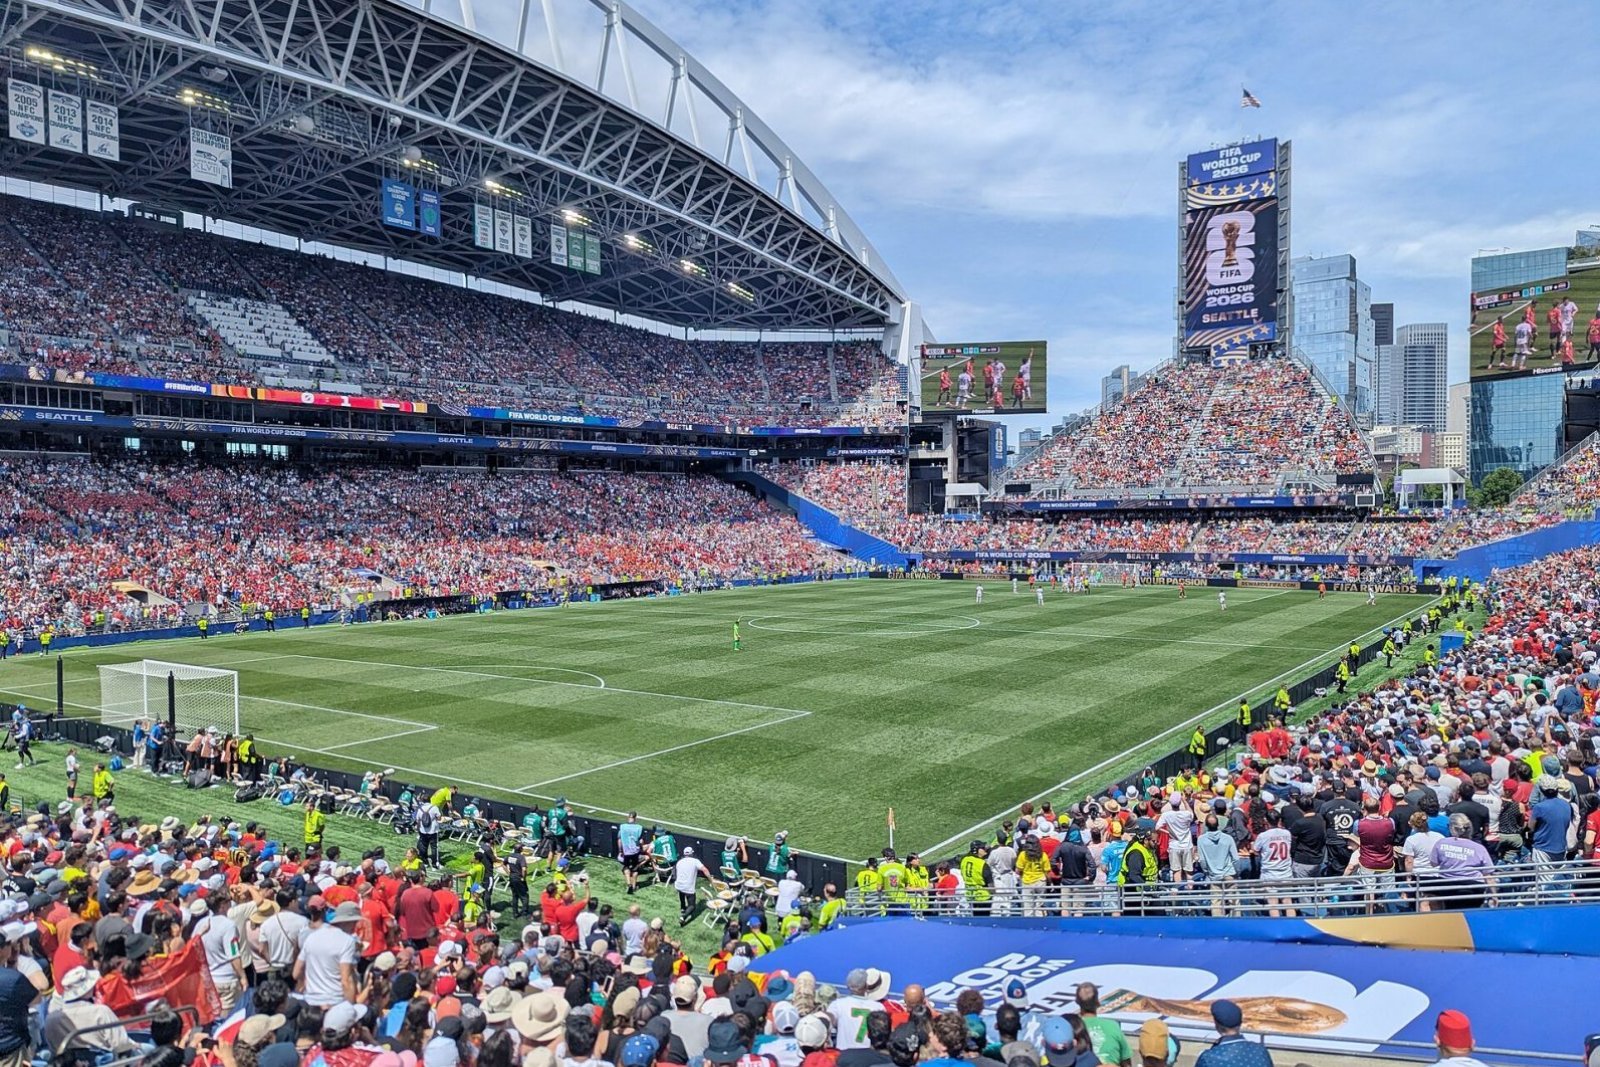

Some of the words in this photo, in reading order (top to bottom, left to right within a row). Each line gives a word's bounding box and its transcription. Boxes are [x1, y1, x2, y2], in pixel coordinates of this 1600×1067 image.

[14, 94, 38, 107] 2005
[18, 104, 35, 114] NFC
[53, 105, 77, 118] 2013
[9, 110, 44, 123] CHAMPIONS
[57, 115, 74, 125] NFC
[91, 114, 114, 127] 2014
[95, 124, 111, 134] NFC
[192, 129, 208, 139] 2013
[192, 136, 230, 150] CHAMPIONS
[1219, 146, 1242, 159] FIFA
[1201, 157, 1239, 172] WORLD
[1240, 152, 1262, 164] CUP
[1212, 164, 1249, 179] 2026
[1220, 269, 1242, 279] FIFA
[1206, 285, 1237, 296] WORLD
[1237, 284, 1255, 293] CUP
[1205, 292, 1255, 308] 2026
[1202, 308, 1259, 323] SEATTLE
[1533, 366, 1563, 375] Hisense
[35, 411, 94, 422] SEATTLE
[508, 411, 524, 419] FIFA
[524, 412, 548, 421] WORLD
[548, 414, 562, 422] CUP
[561, 415, 585, 424] 2026
[247, 427, 271, 436] WORLD
[270, 428, 284, 436] CUP
[284, 429, 307, 437] 2026
[666, 423, 693, 431] SEATTLE
[438, 436, 474, 444] SEATTLE
[1140, 576, 1166, 585] YOUR
[1333, 583, 1358, 592] FIFA
[1269, 841, 1288, 861] 20
[851, 1007, 871, 1043] 7
